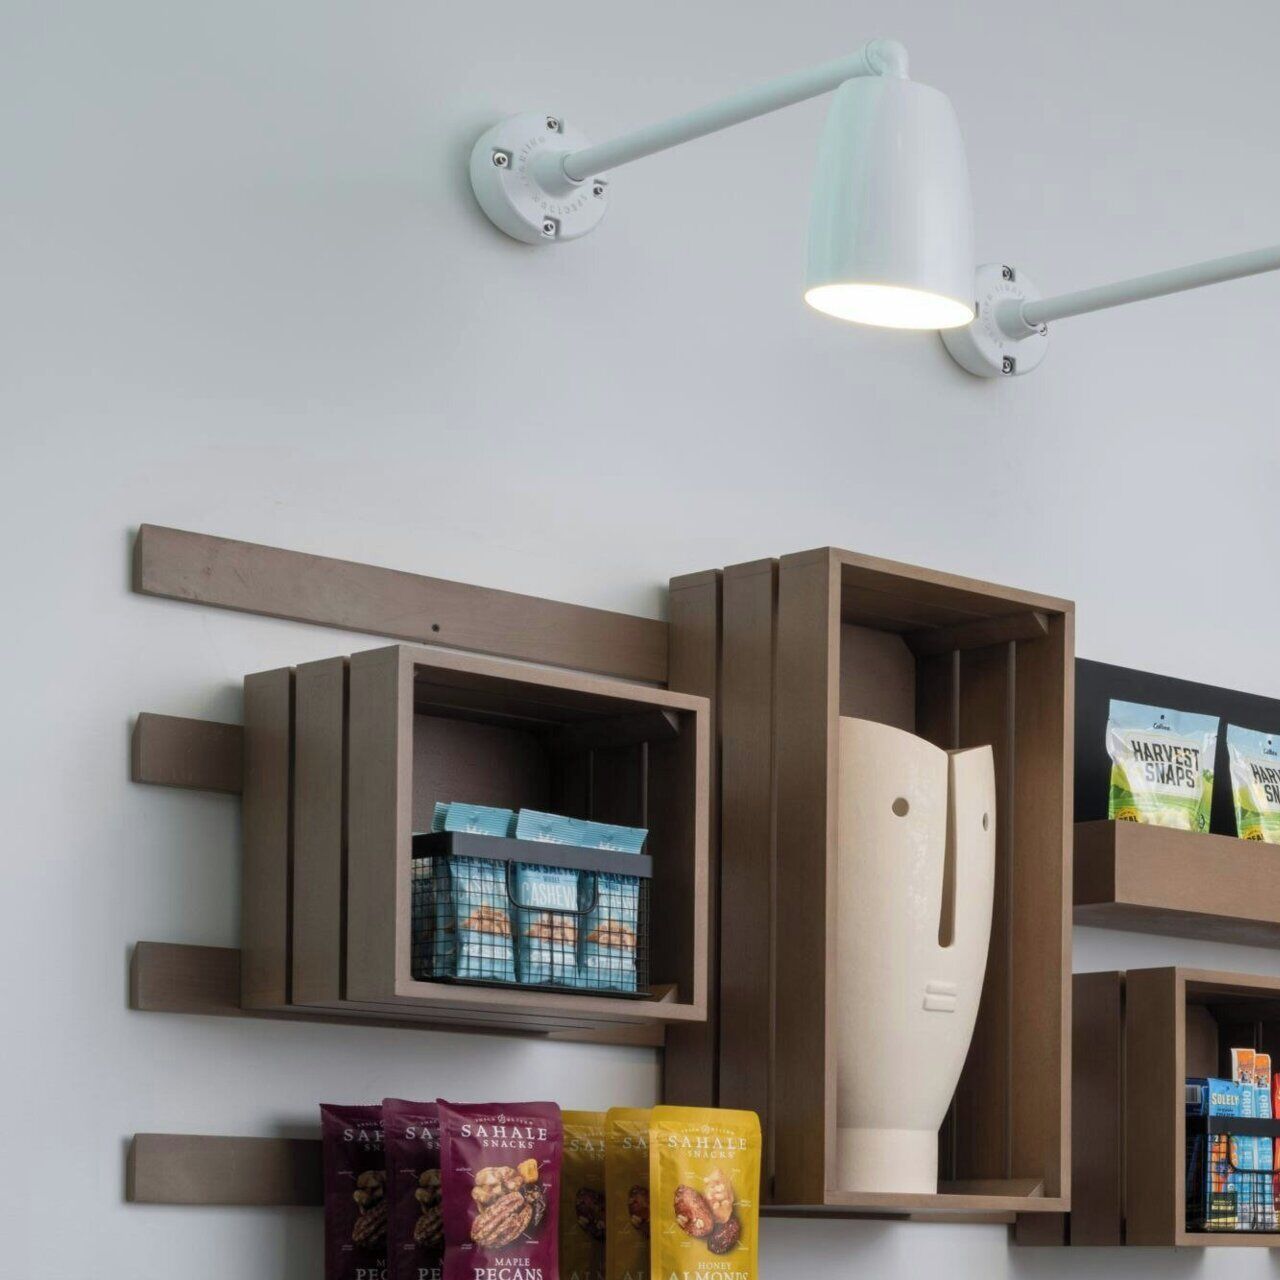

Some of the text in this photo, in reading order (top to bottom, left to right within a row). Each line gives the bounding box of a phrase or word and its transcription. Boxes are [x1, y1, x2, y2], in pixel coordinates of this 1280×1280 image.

[1131, 740, 1200, 771] HARVEST
[1145, 762, 1195, 788] SNAPS
[1211, 1092, 1240, 1106] SOLELY
[461, 1124, 547, 1141] SAHALE
[483, 1139, 534, 1149] SNACKS
[668, 1135, 747, 1151] SAHALE
[688, 1150, 735, 1160] SNACKS
[495, 1258, 531, 1267] MAPLE
[698, 1262, 731, 1270] HONEY
